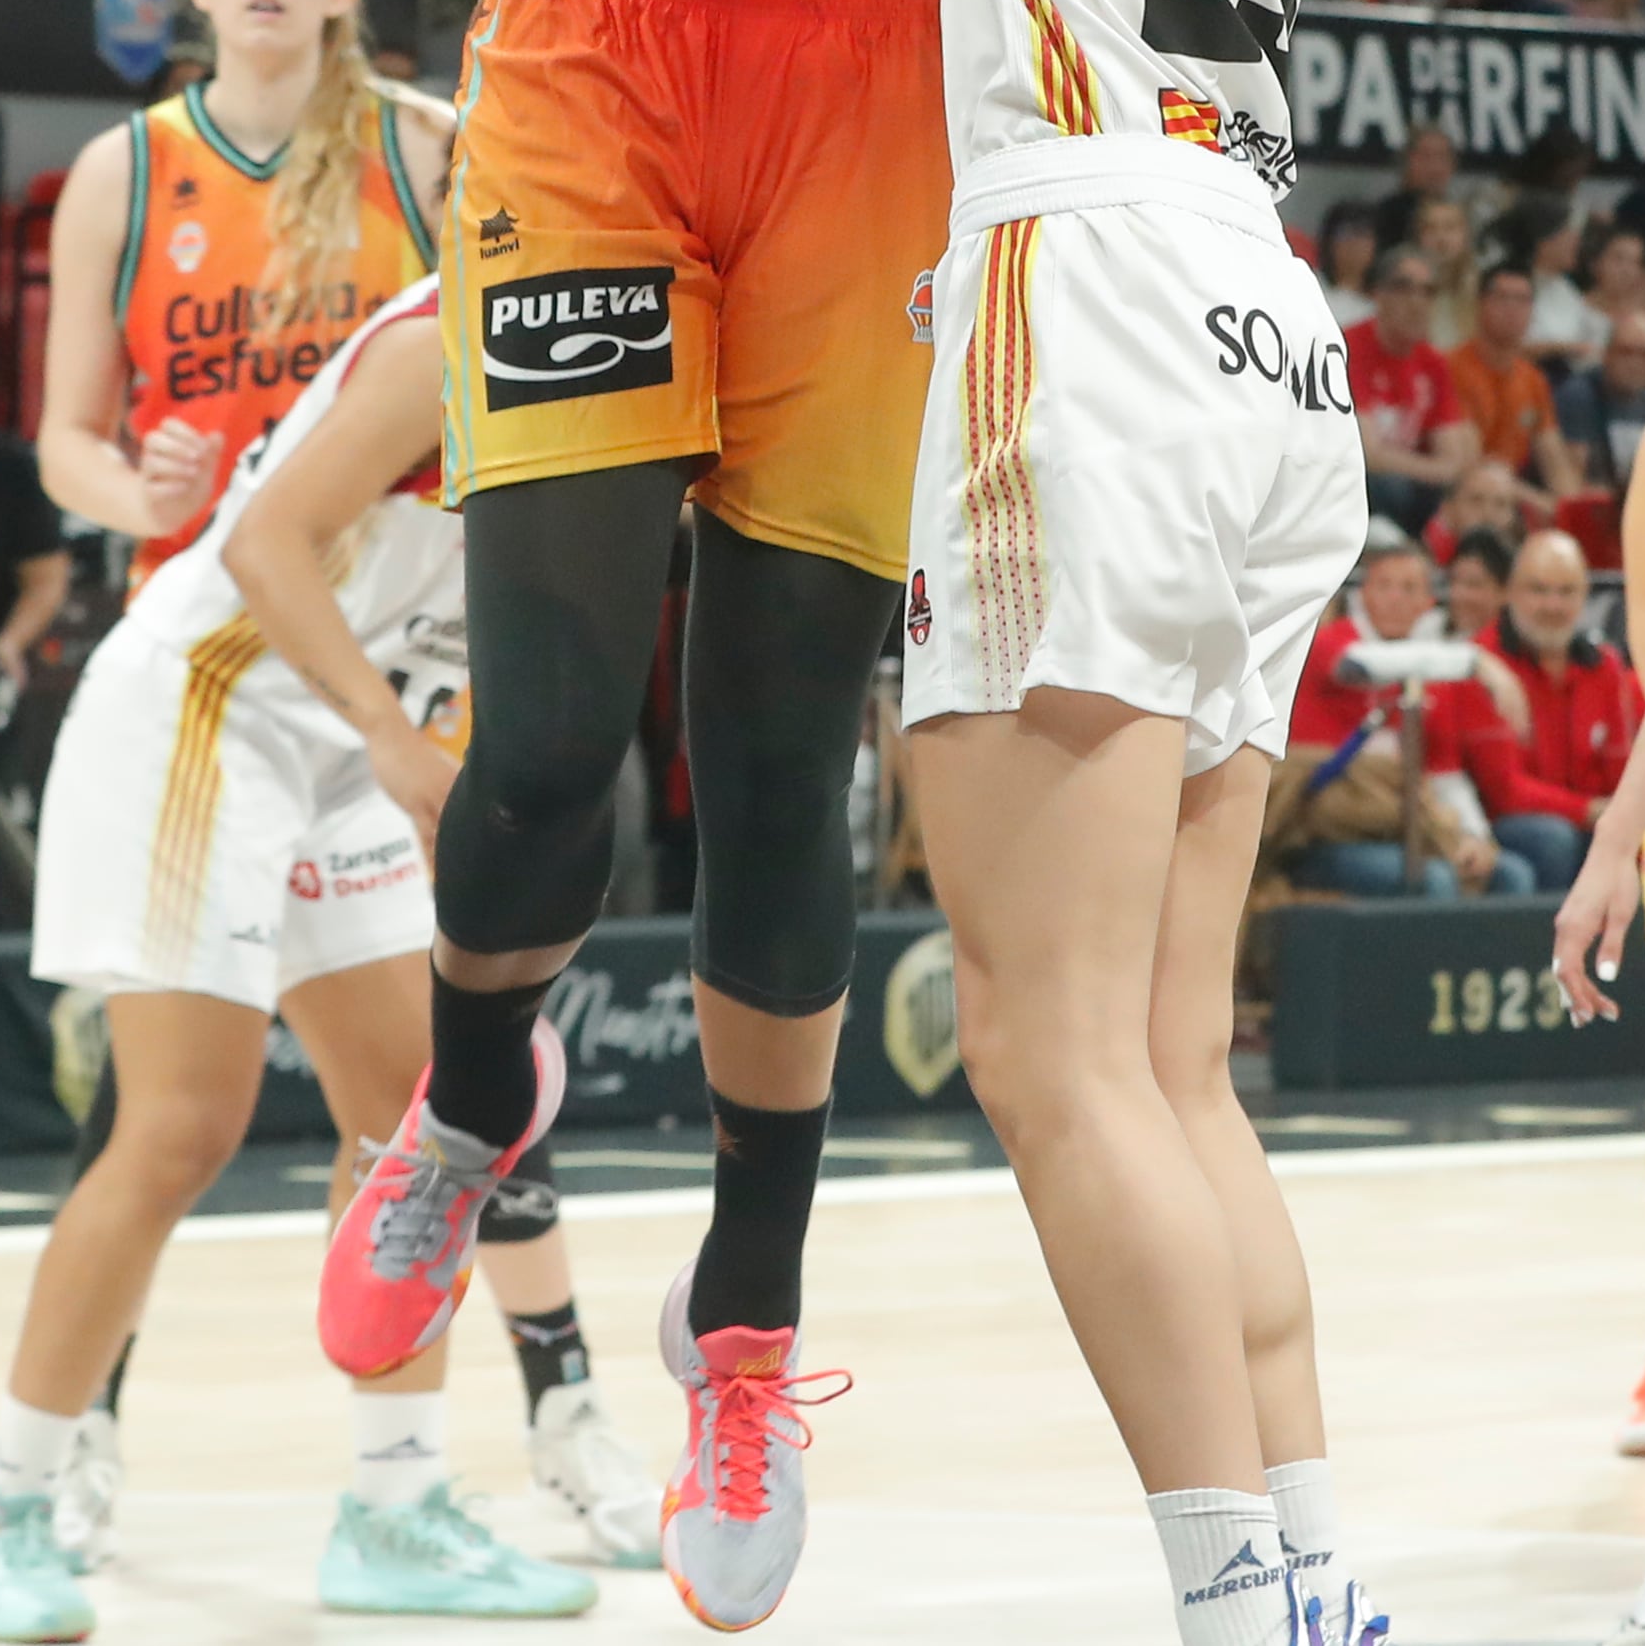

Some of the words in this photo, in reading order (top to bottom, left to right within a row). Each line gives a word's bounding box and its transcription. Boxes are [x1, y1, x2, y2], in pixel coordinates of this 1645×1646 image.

[1409, 39, 1458, 92] DE
[490, 283, 659, 336] PULEVA
[1428, 968, 1566, 1034] 1923
